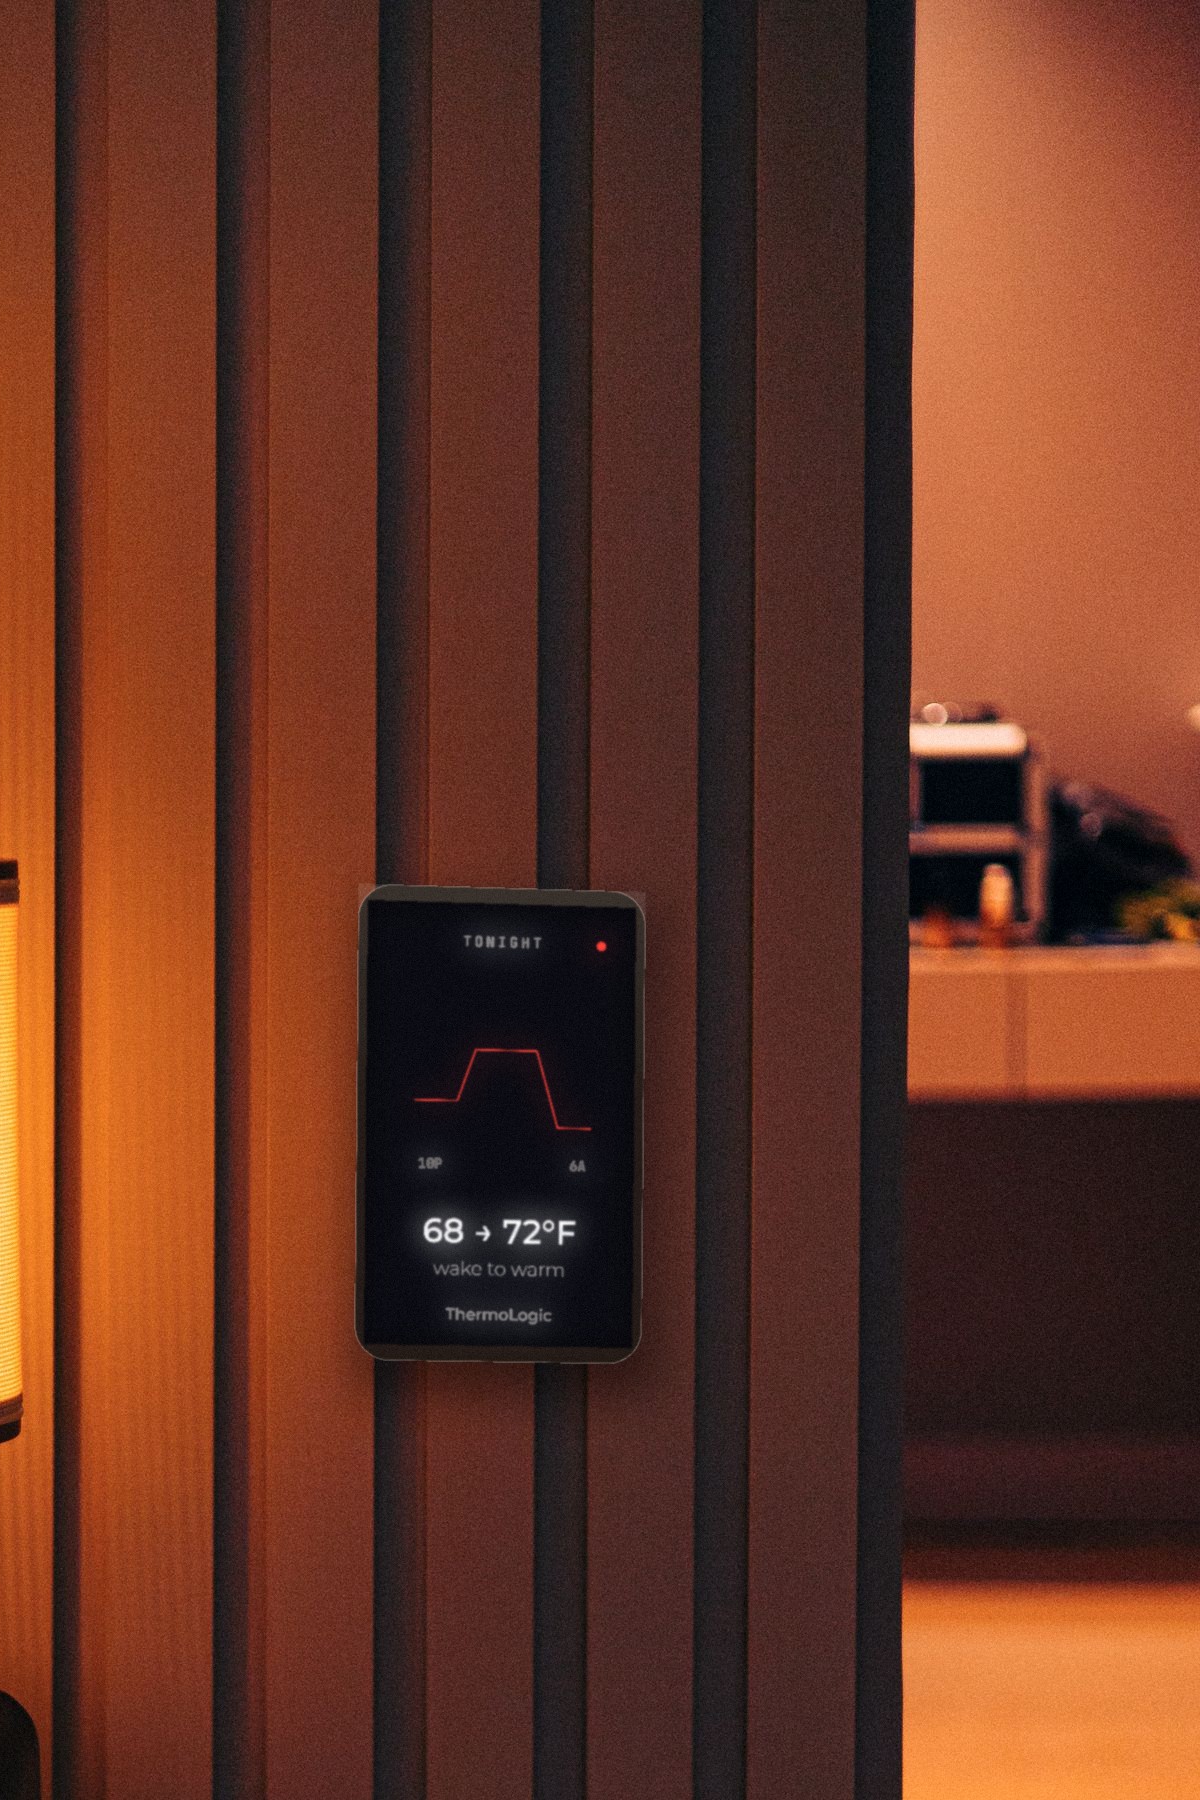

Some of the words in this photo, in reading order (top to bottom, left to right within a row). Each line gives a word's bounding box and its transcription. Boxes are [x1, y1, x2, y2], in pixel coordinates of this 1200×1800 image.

[463, 934, 542, 949] TONIGHT
[417, 1156, 443, 1170] 10P
[568, 1159, 586, 1173] 6A
[423, 1217, 464, 1244] 68
[502, 1219, 576, 1246] 72°F
[432, 1260, 483, 1277] wake
[487, 1262, 507, 1277] to
[510, 1264, 565, 1278] warm
[445, 1306, 552, 1326] ThermoLogic
